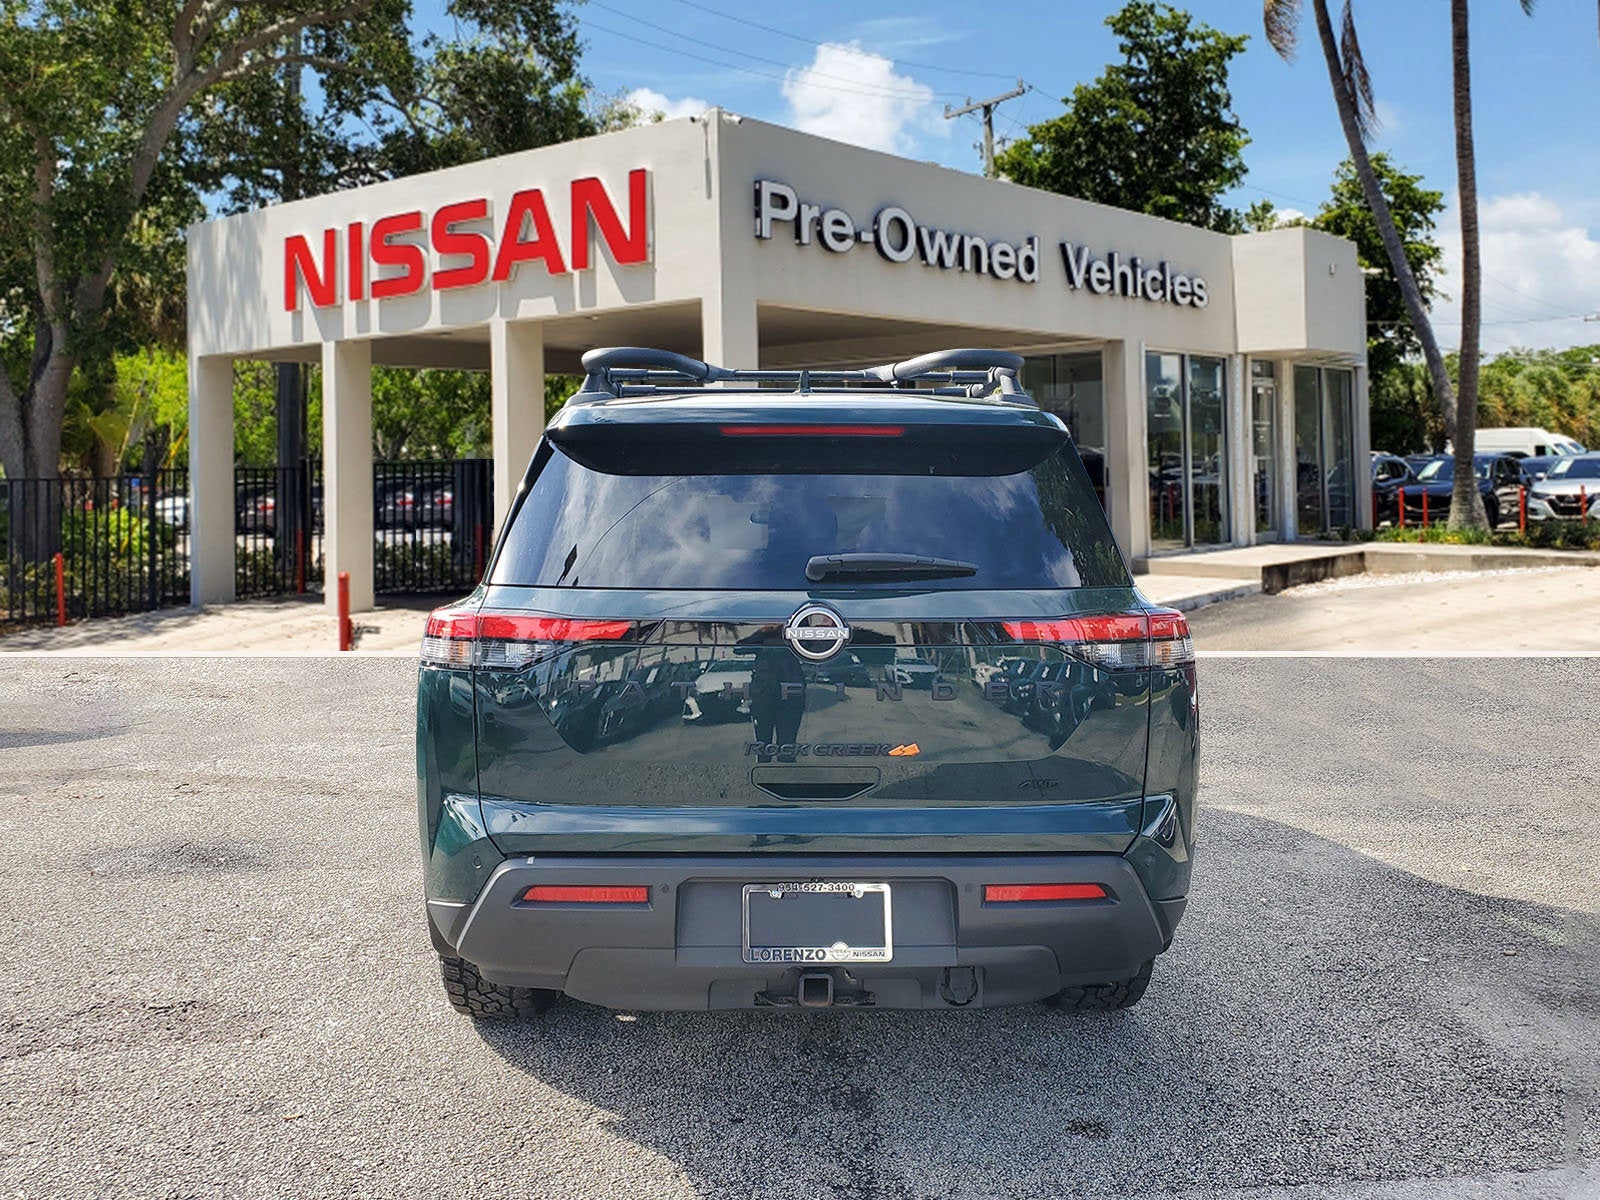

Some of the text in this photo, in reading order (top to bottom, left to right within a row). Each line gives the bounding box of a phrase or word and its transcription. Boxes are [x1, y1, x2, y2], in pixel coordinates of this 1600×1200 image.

[284, 168, 649, 312] NISSAN
[754, 179, 1209, 309] Pre-Owned Vehicles
[787, 629, 847, 638] NISSAN
[571, 680, 1063, 701] PATHFINDER
[744, 741, 893, 757] ROCK CREEK
[751, 949, 827, 961] LORENZO
